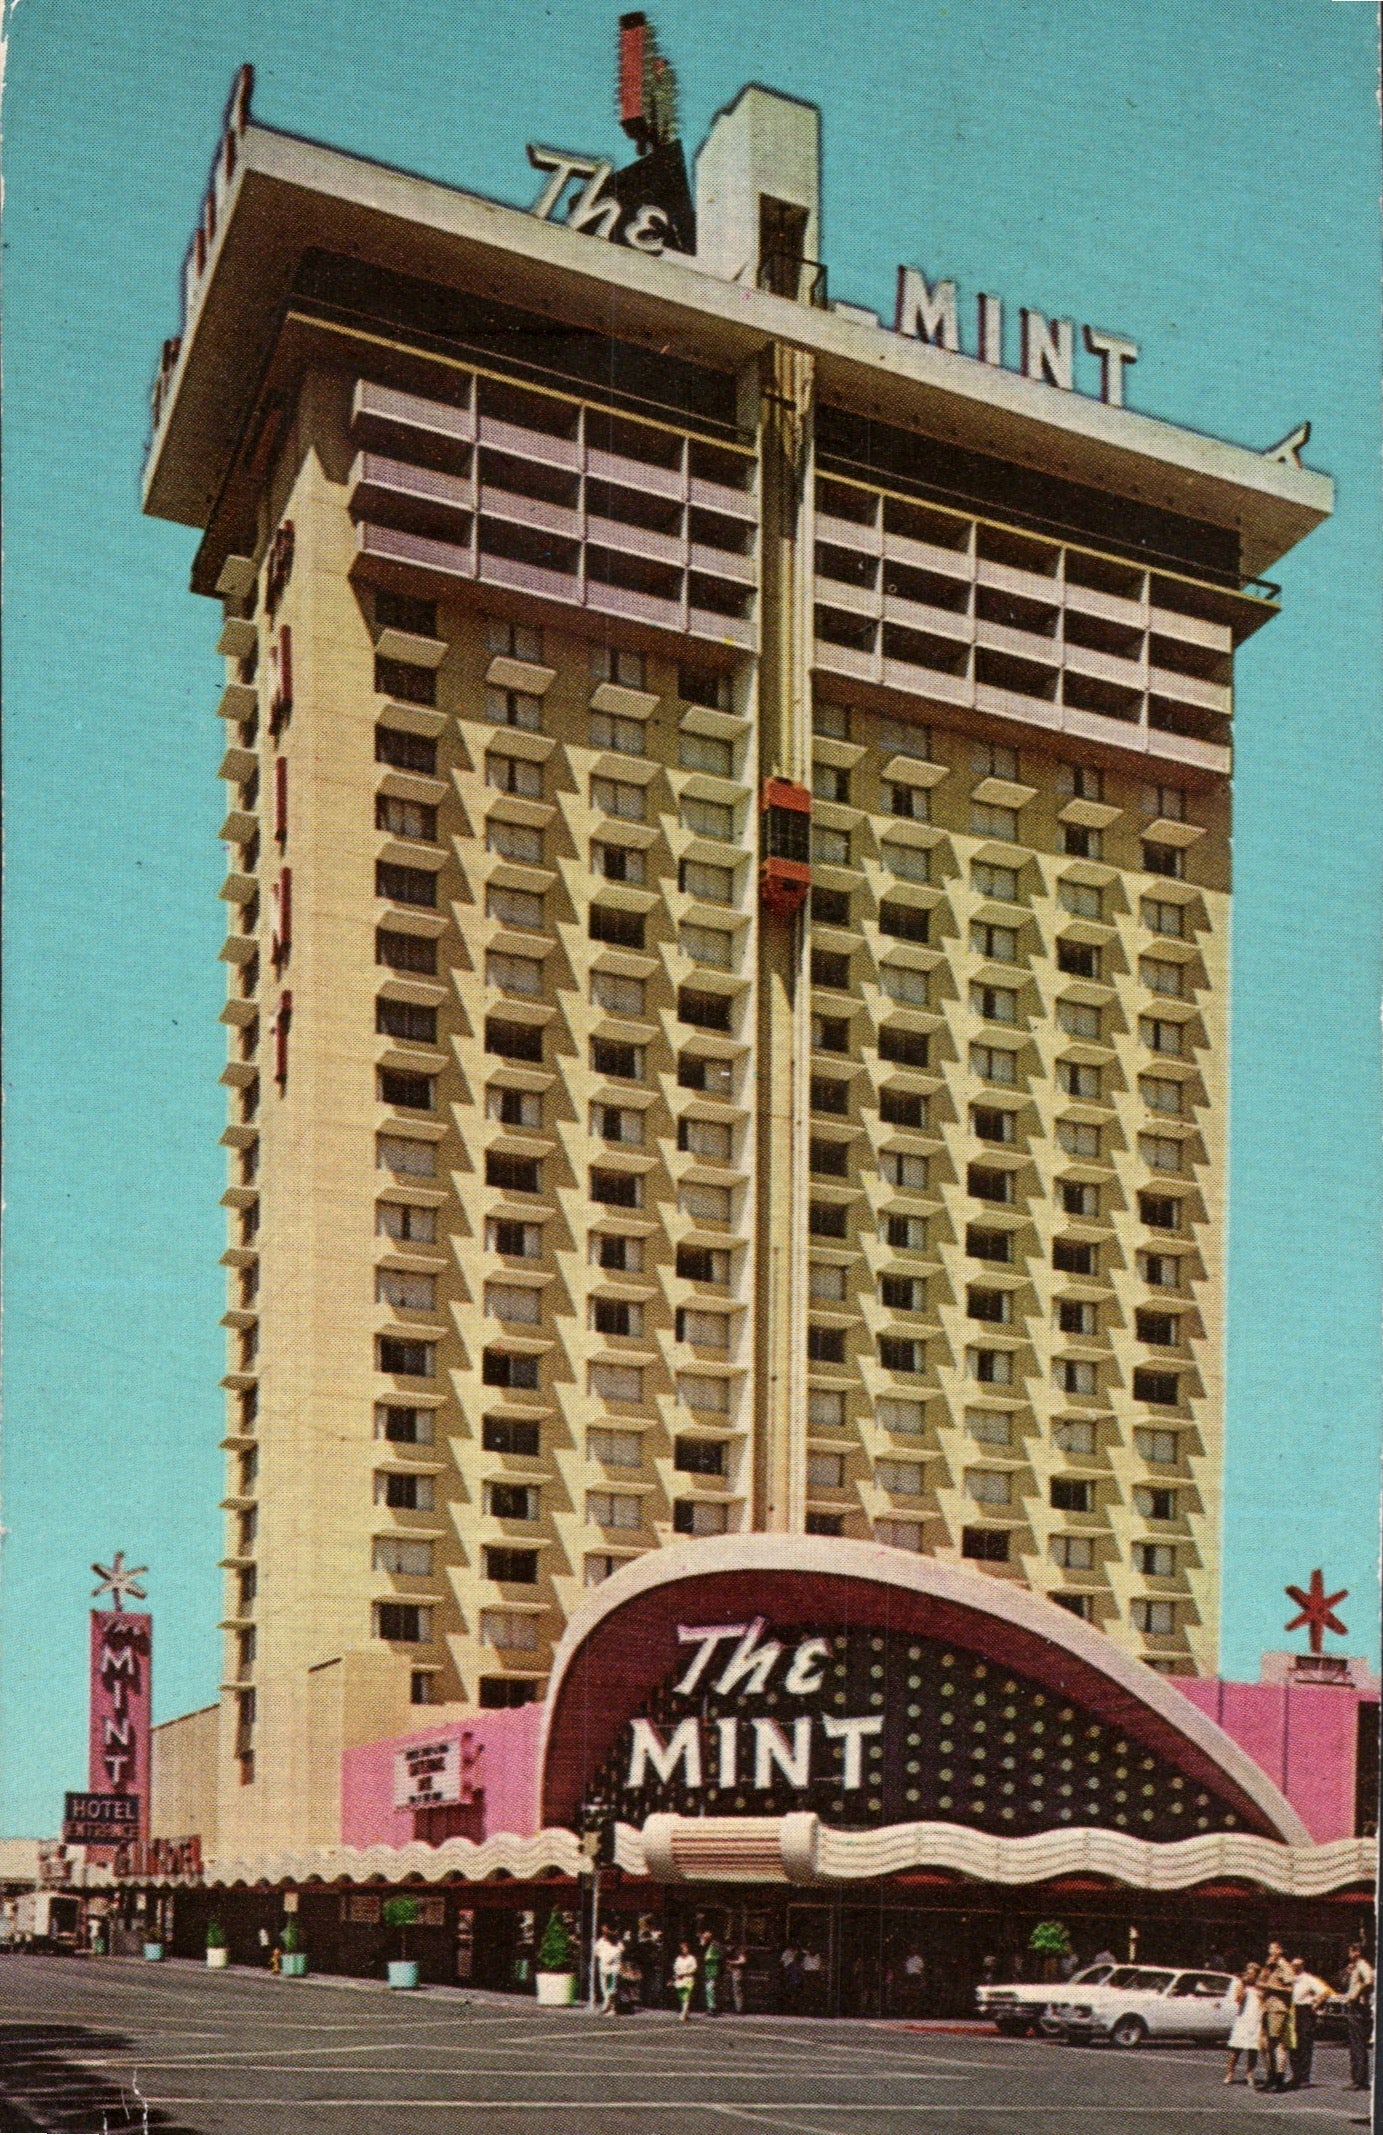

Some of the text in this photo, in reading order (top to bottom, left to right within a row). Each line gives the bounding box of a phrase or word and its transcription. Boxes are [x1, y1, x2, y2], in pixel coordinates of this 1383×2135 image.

[526, 143, 1142, 408] The MINT
[671, 1614, 833, 1696] The
[100, 1642, 135, 1786] MINT
[624, 1712, 885, 1791] MINT
[72, 1799, 136, 1820] HOTEL
